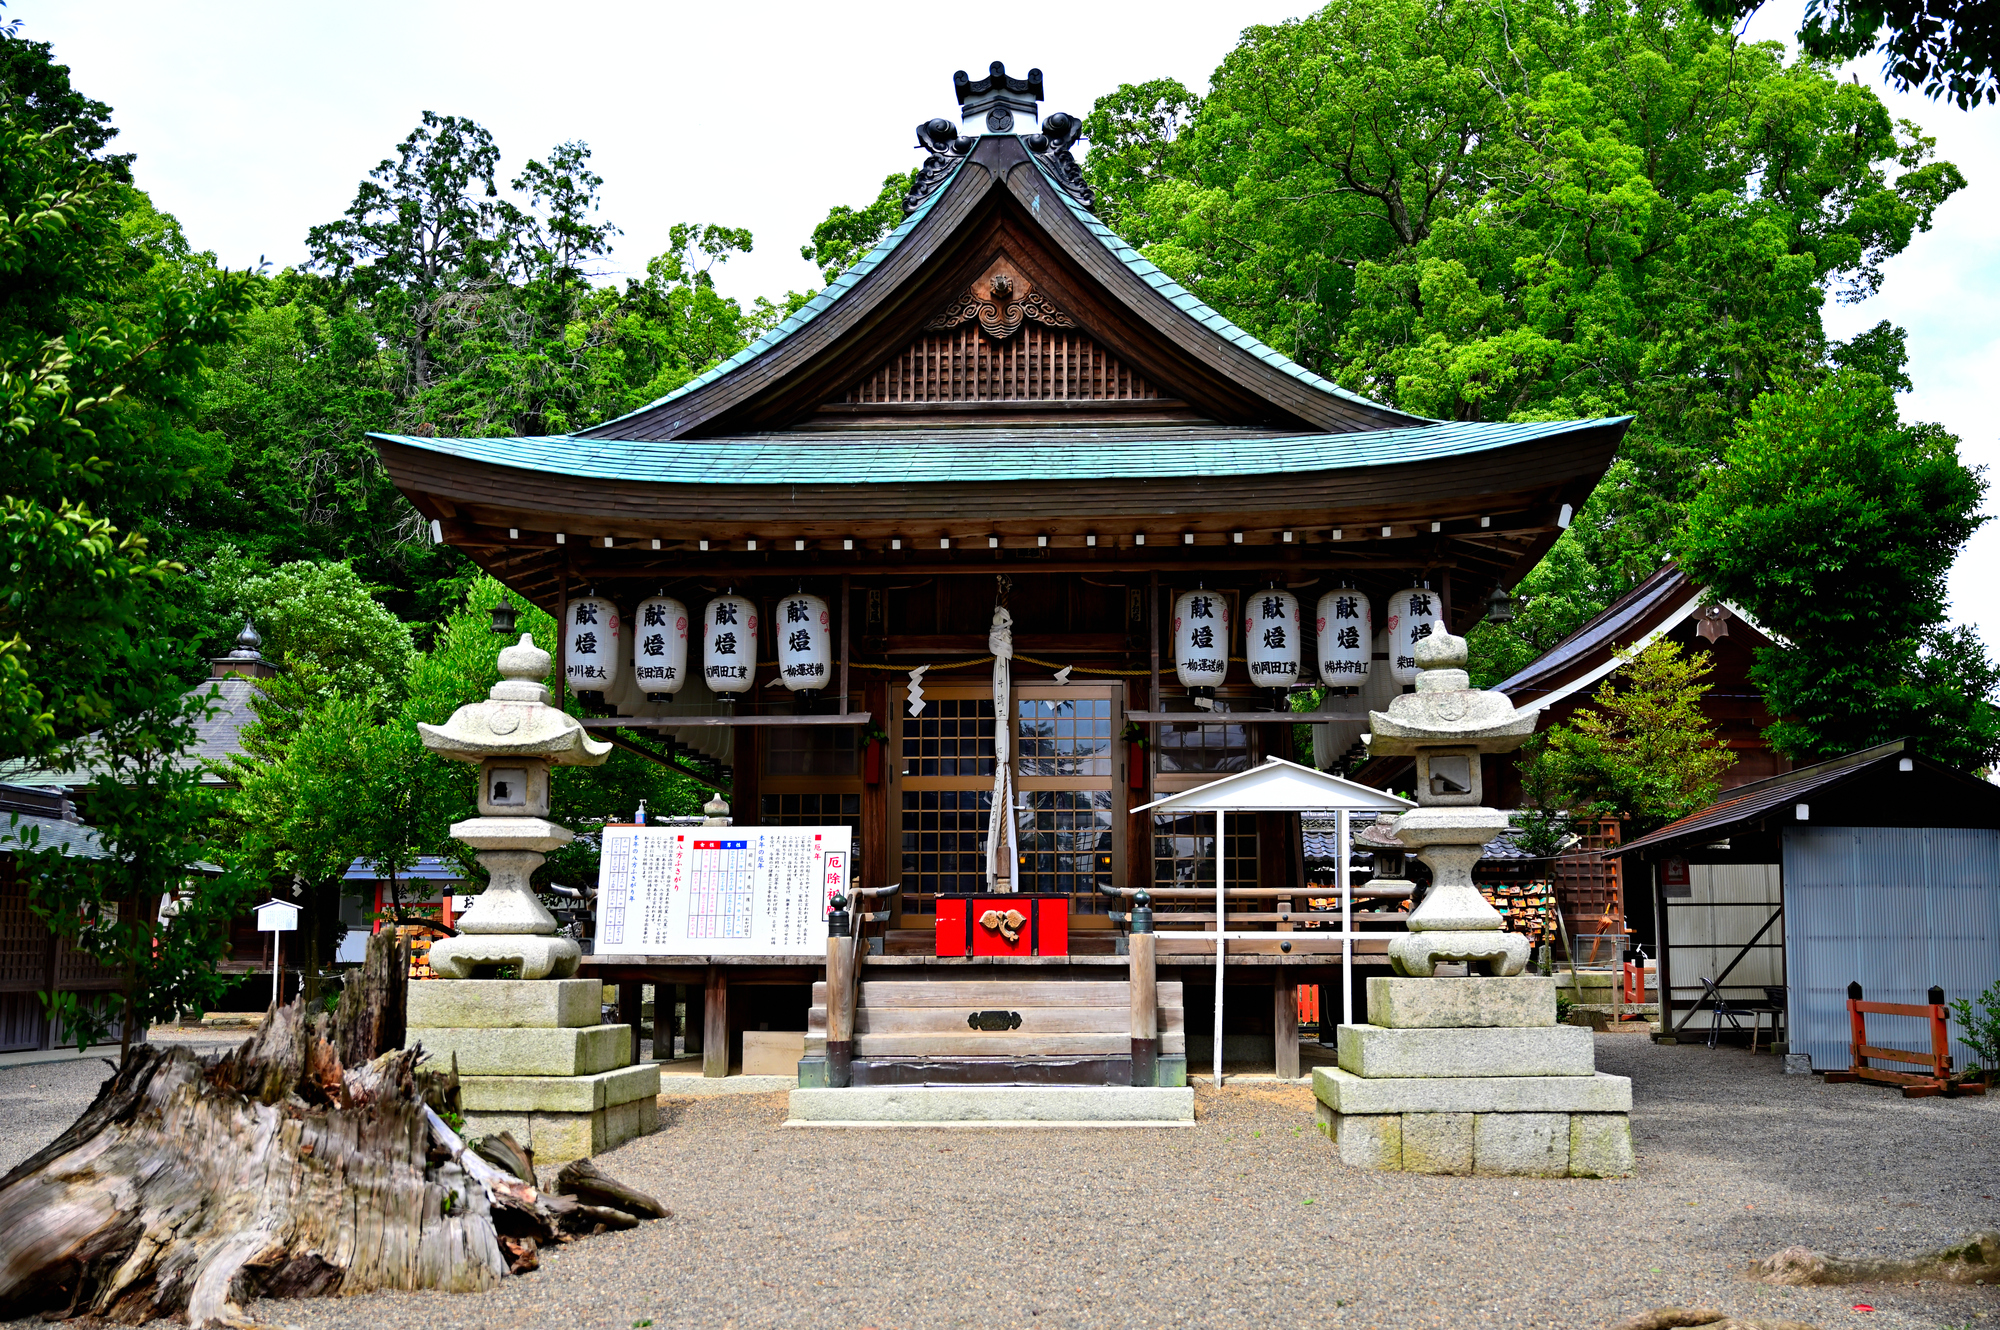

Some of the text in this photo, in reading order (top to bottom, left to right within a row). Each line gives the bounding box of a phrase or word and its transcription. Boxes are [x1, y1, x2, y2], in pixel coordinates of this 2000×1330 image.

[575, 603, 598, 654] 献燈
[643, 604, 666, 656] 献燈
[715, 602, 738, 655] 献燈
[787, 600, 811, 652] 献燈
[1191, 596, 1214, 649] 献燈
[1262, 596, 1286, 649] 献燈
[1336, 596, 1360, 649] 献燈
